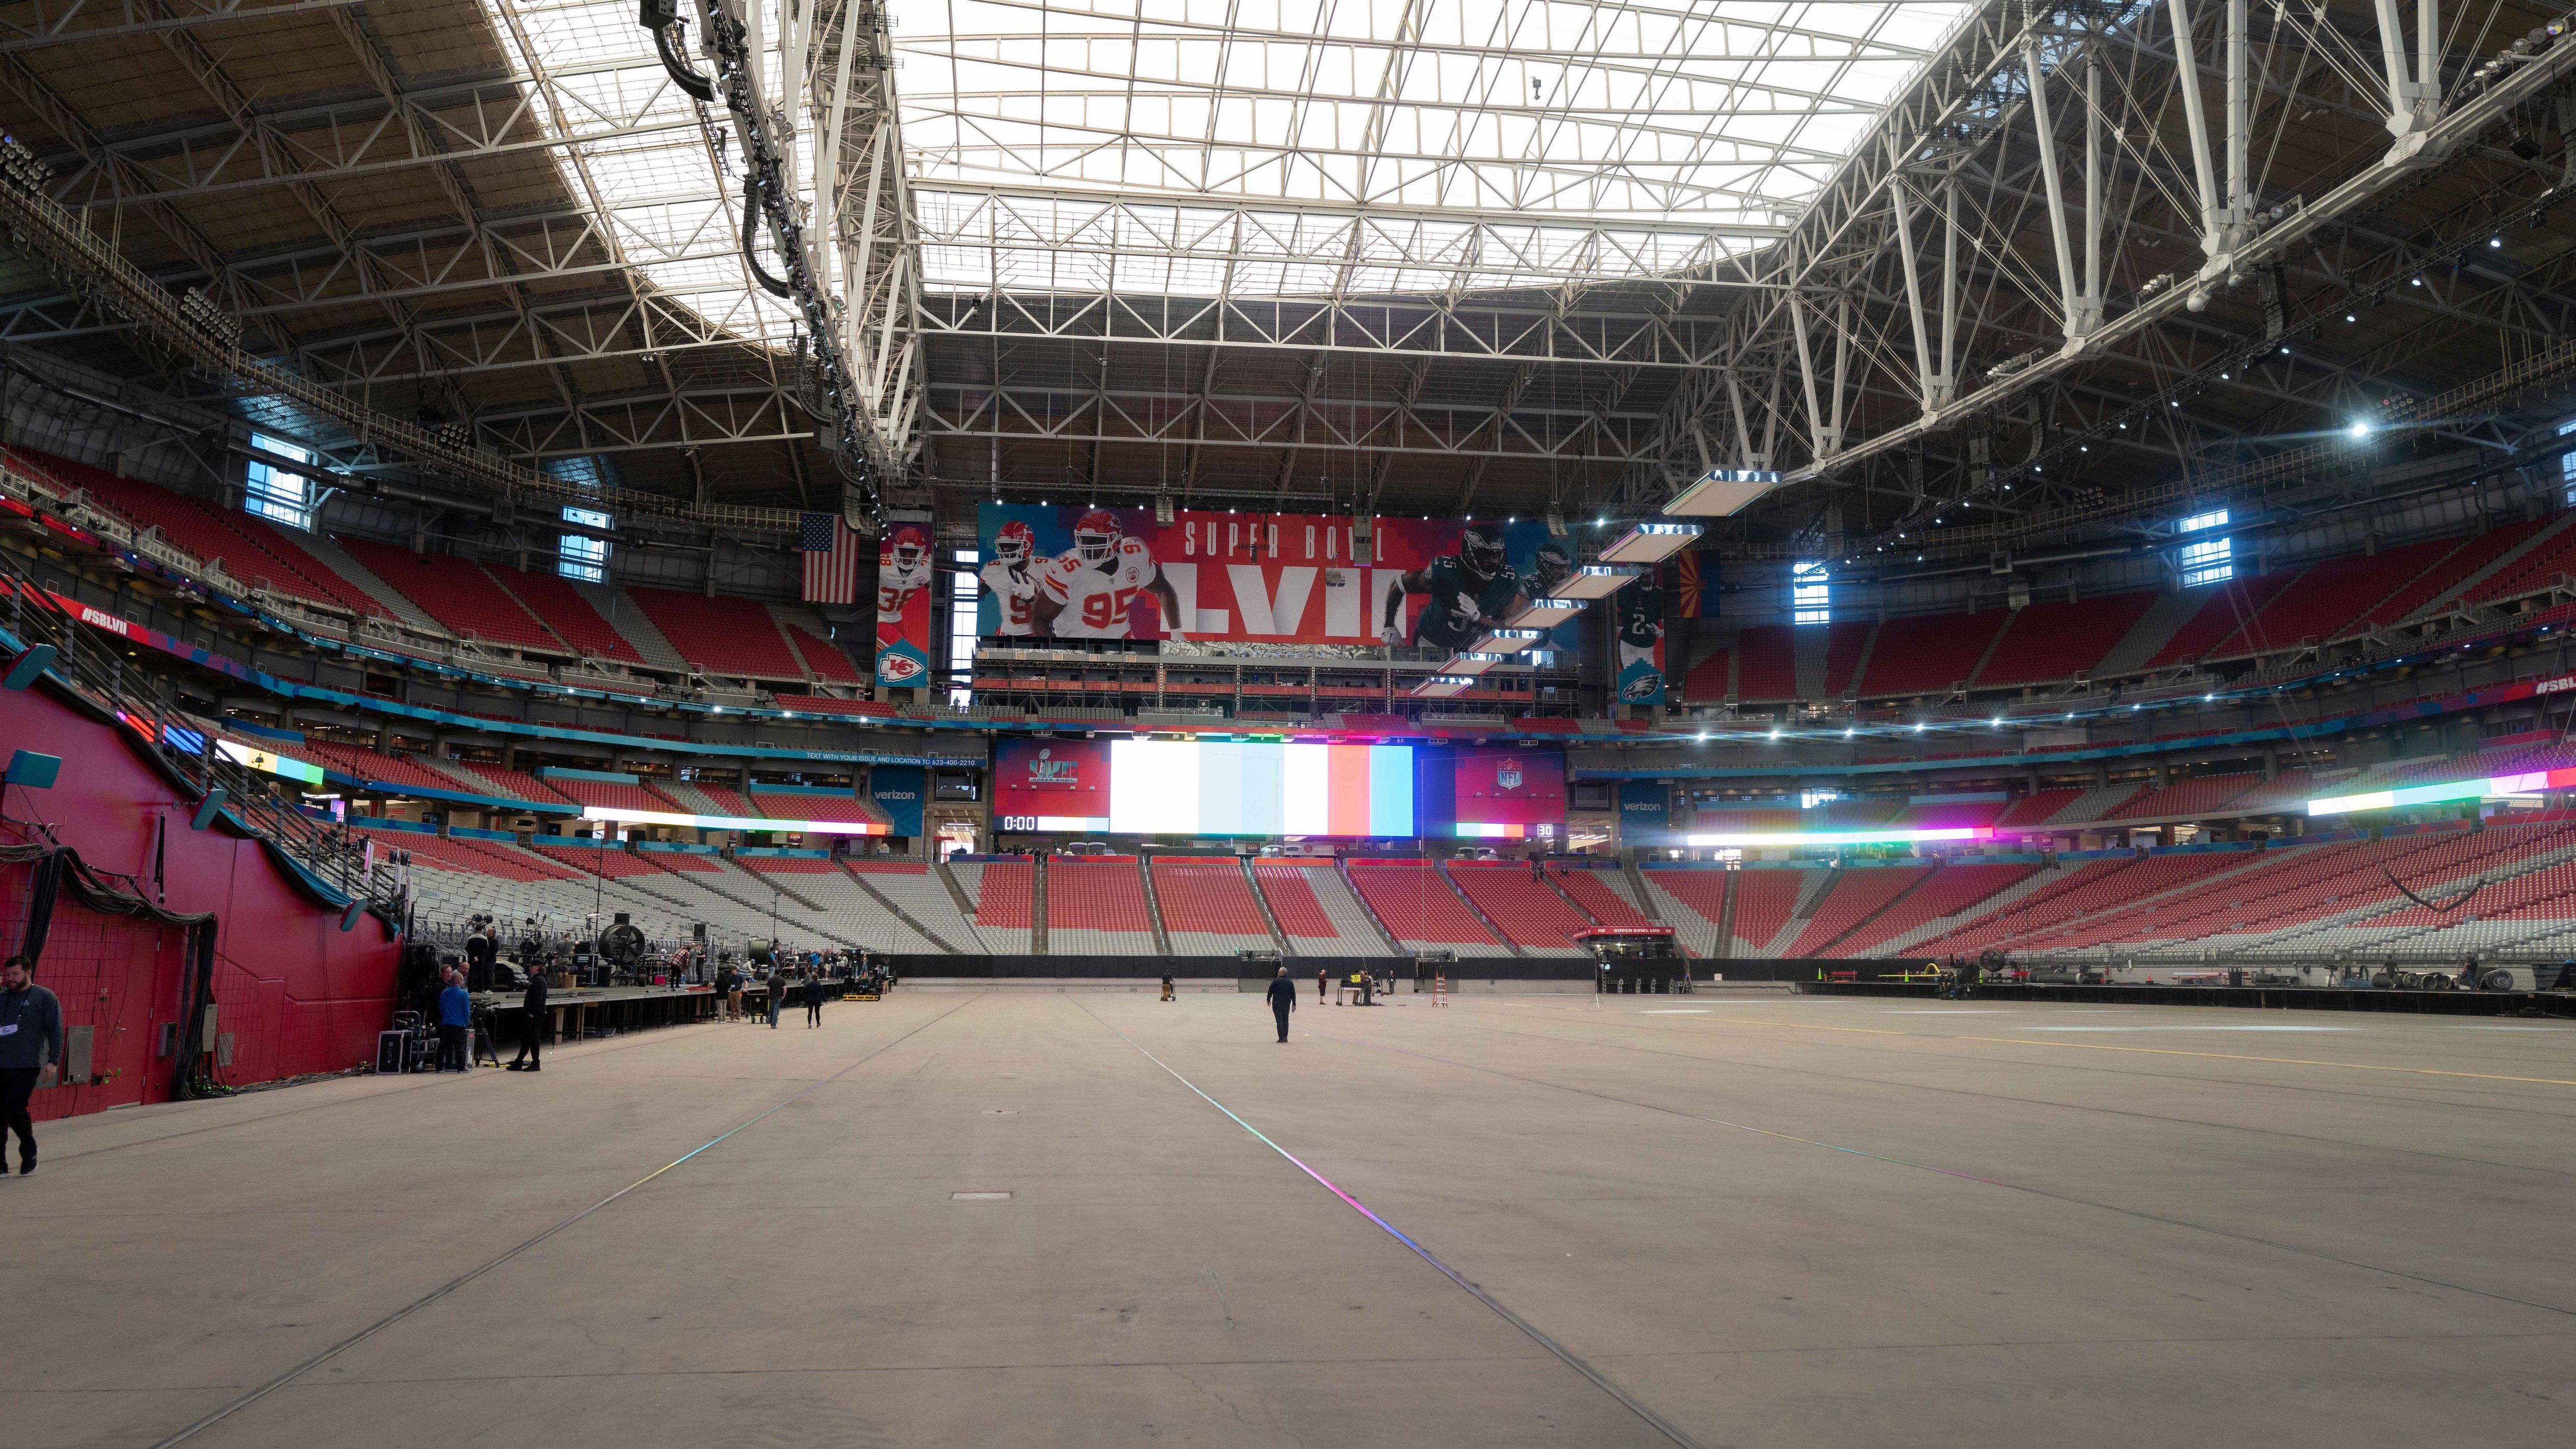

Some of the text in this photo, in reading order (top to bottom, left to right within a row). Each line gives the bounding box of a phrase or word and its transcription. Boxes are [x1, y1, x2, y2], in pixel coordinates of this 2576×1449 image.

[1185, 521, 1278, 558] SUPER
[1081, 585, 1138, 630] 95
[1160, 562, 1407, 638] LVII
[82, 607, 127, 635] #SBLVII
[1632, 613, 1646, 635] 2
[890, 659, 913, 675] KC
[1029, 760, 1078, 778] LVII
[1500, 772, 1519, 785] NFL
[874, 789, 915, 799] verizon
[1623, 802, 1661, 811] verizon
[1005, 816, 1035, 830] 0:00
[1538, 825, 1552, 836] 30
